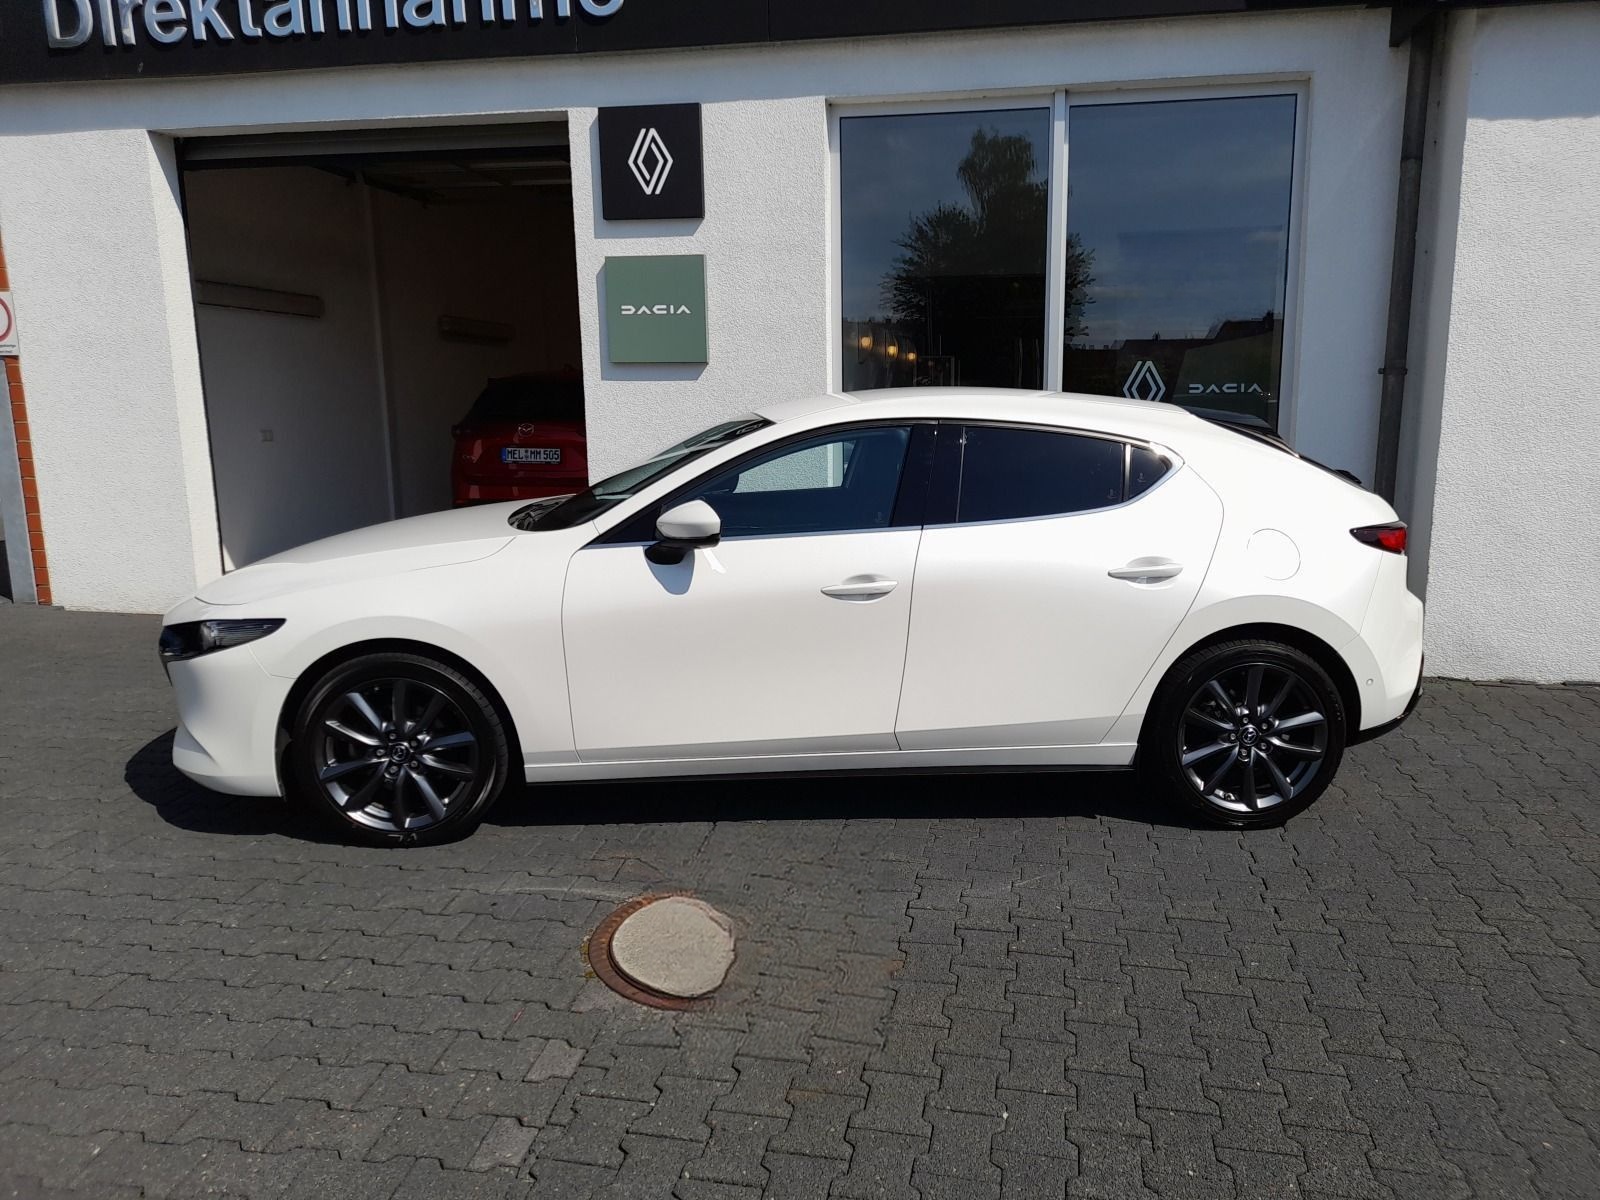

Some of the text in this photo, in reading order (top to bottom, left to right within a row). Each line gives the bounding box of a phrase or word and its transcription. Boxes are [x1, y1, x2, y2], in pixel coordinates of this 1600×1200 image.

[621, 305, 691, 315] DACIA
[1188, 383, 1263, 394] DACIA
[507, 449, 524, 460] MEL
[543, 449, 560, 460] 505
